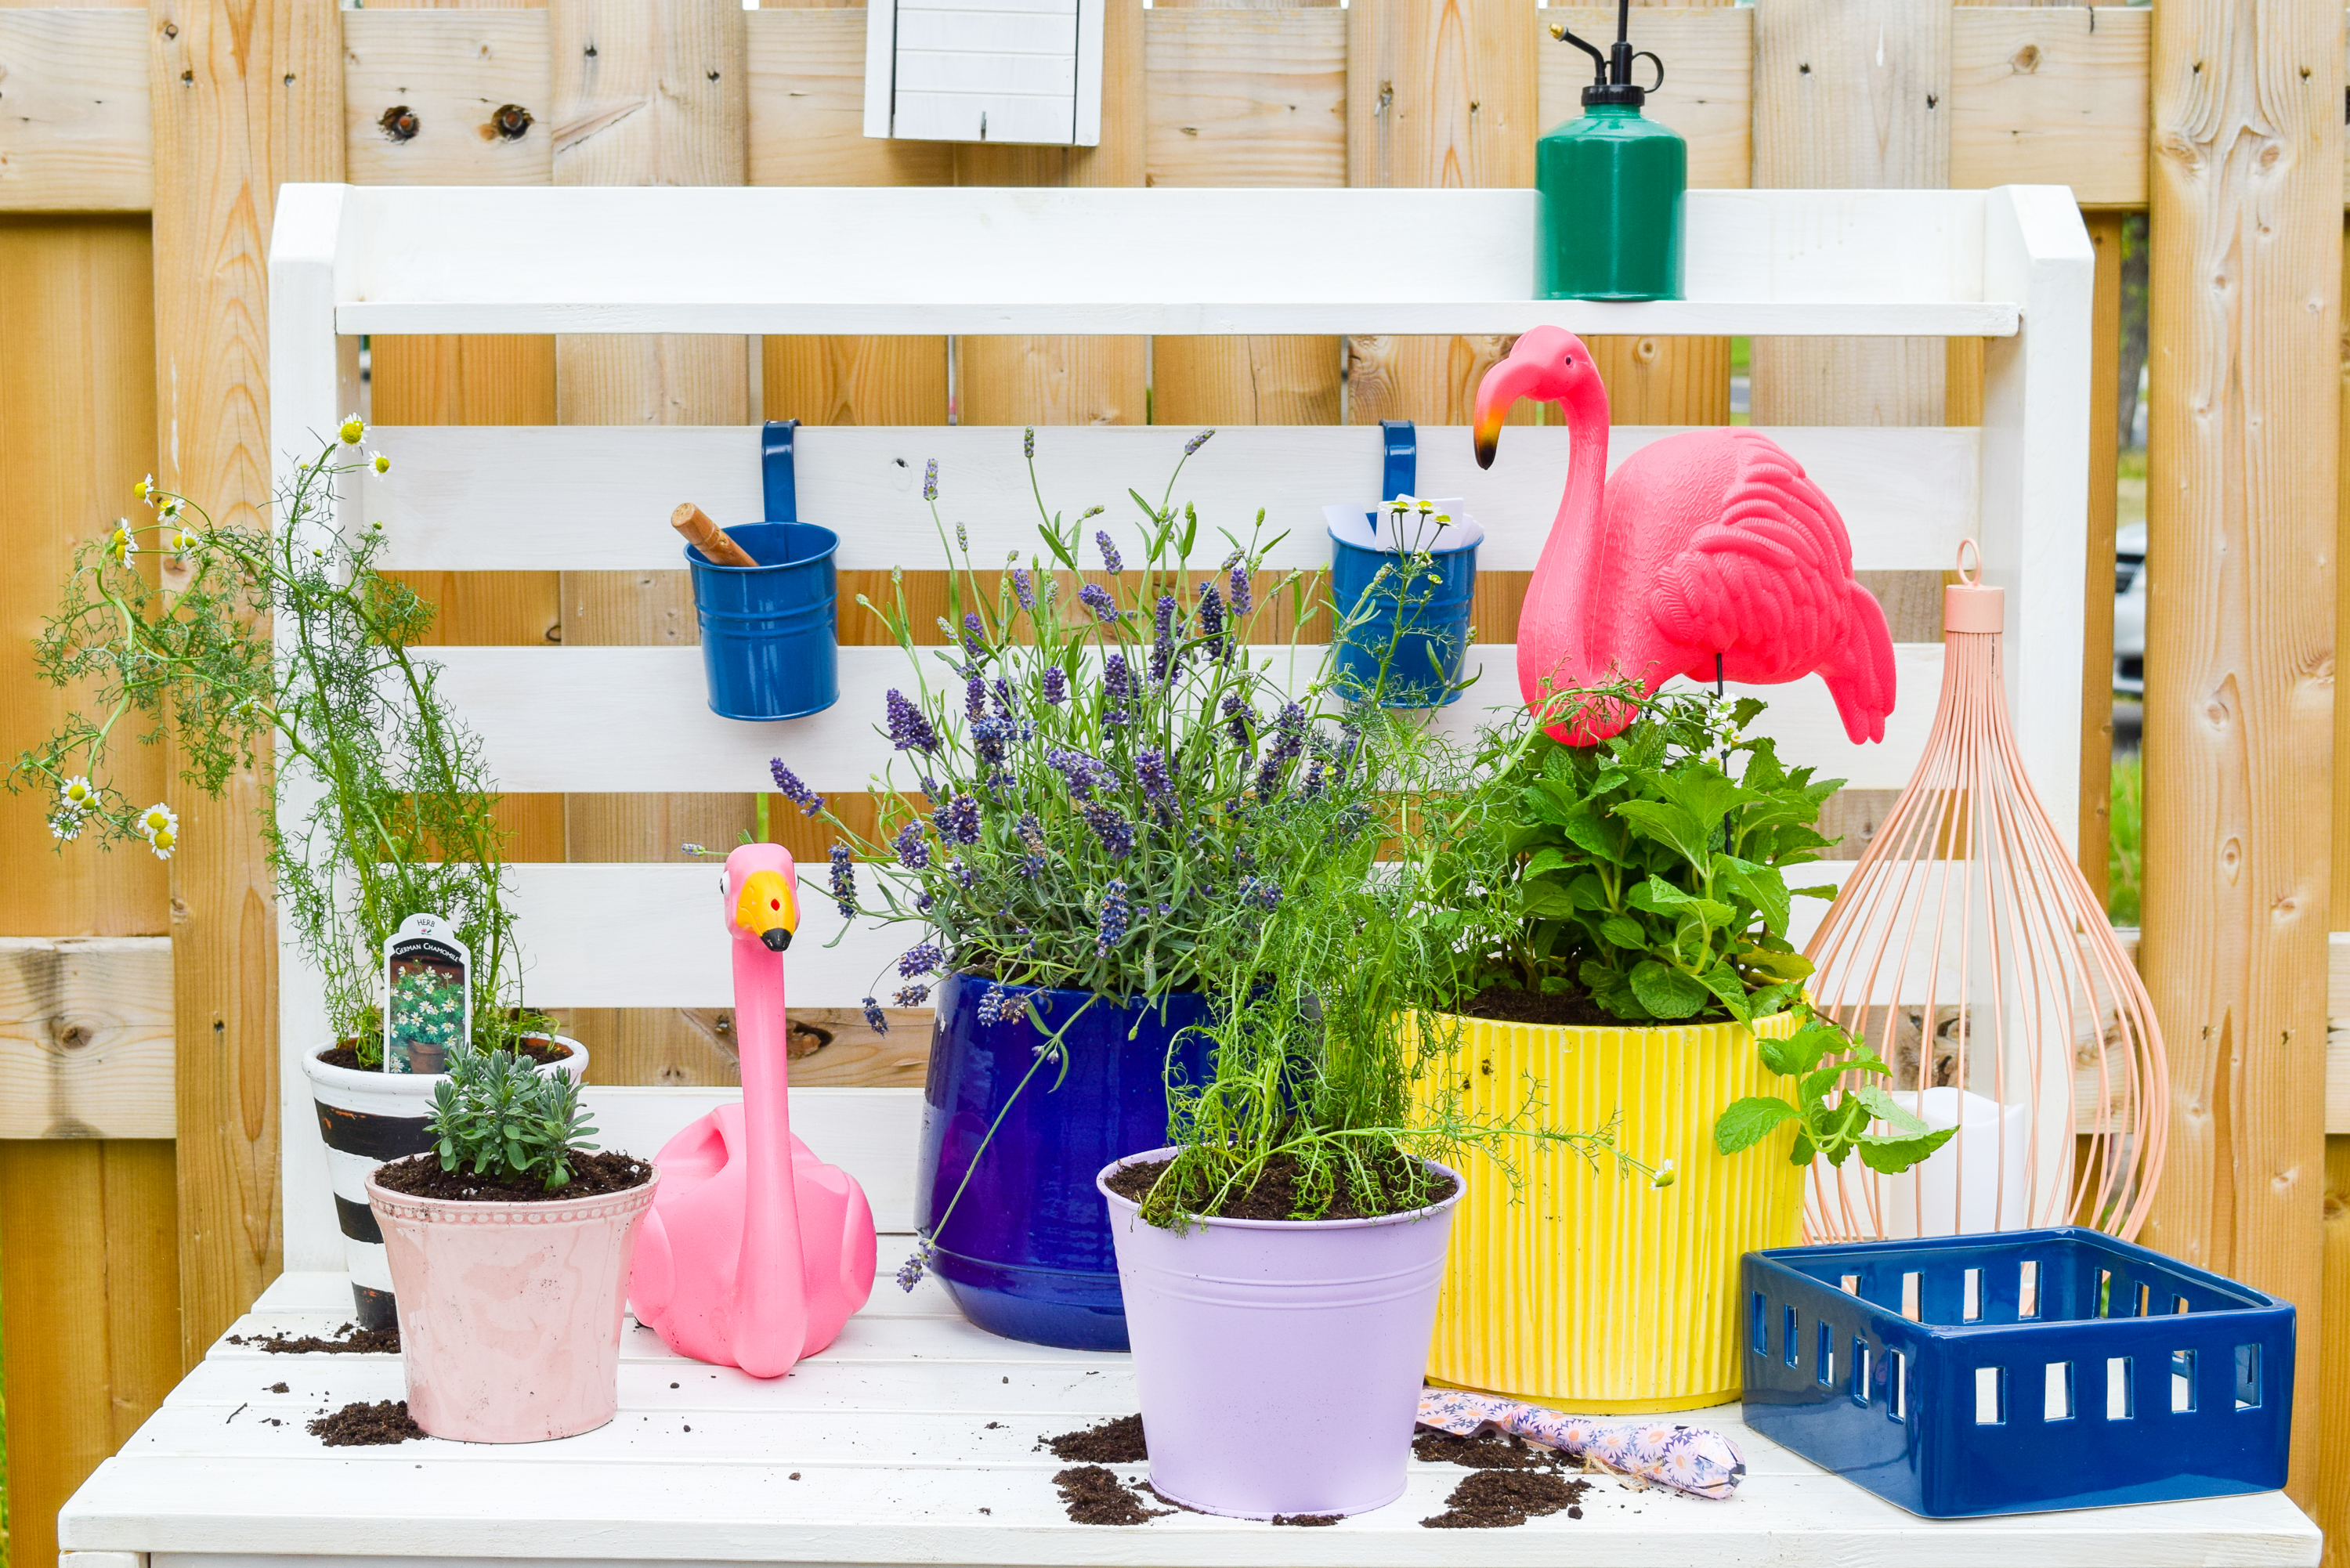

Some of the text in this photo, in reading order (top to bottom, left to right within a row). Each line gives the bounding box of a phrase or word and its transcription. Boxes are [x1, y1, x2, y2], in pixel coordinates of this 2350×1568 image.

[417, 918, 436, 927] HERB
[395, 942, 459, 963] GERMAN CHAMOMILE
